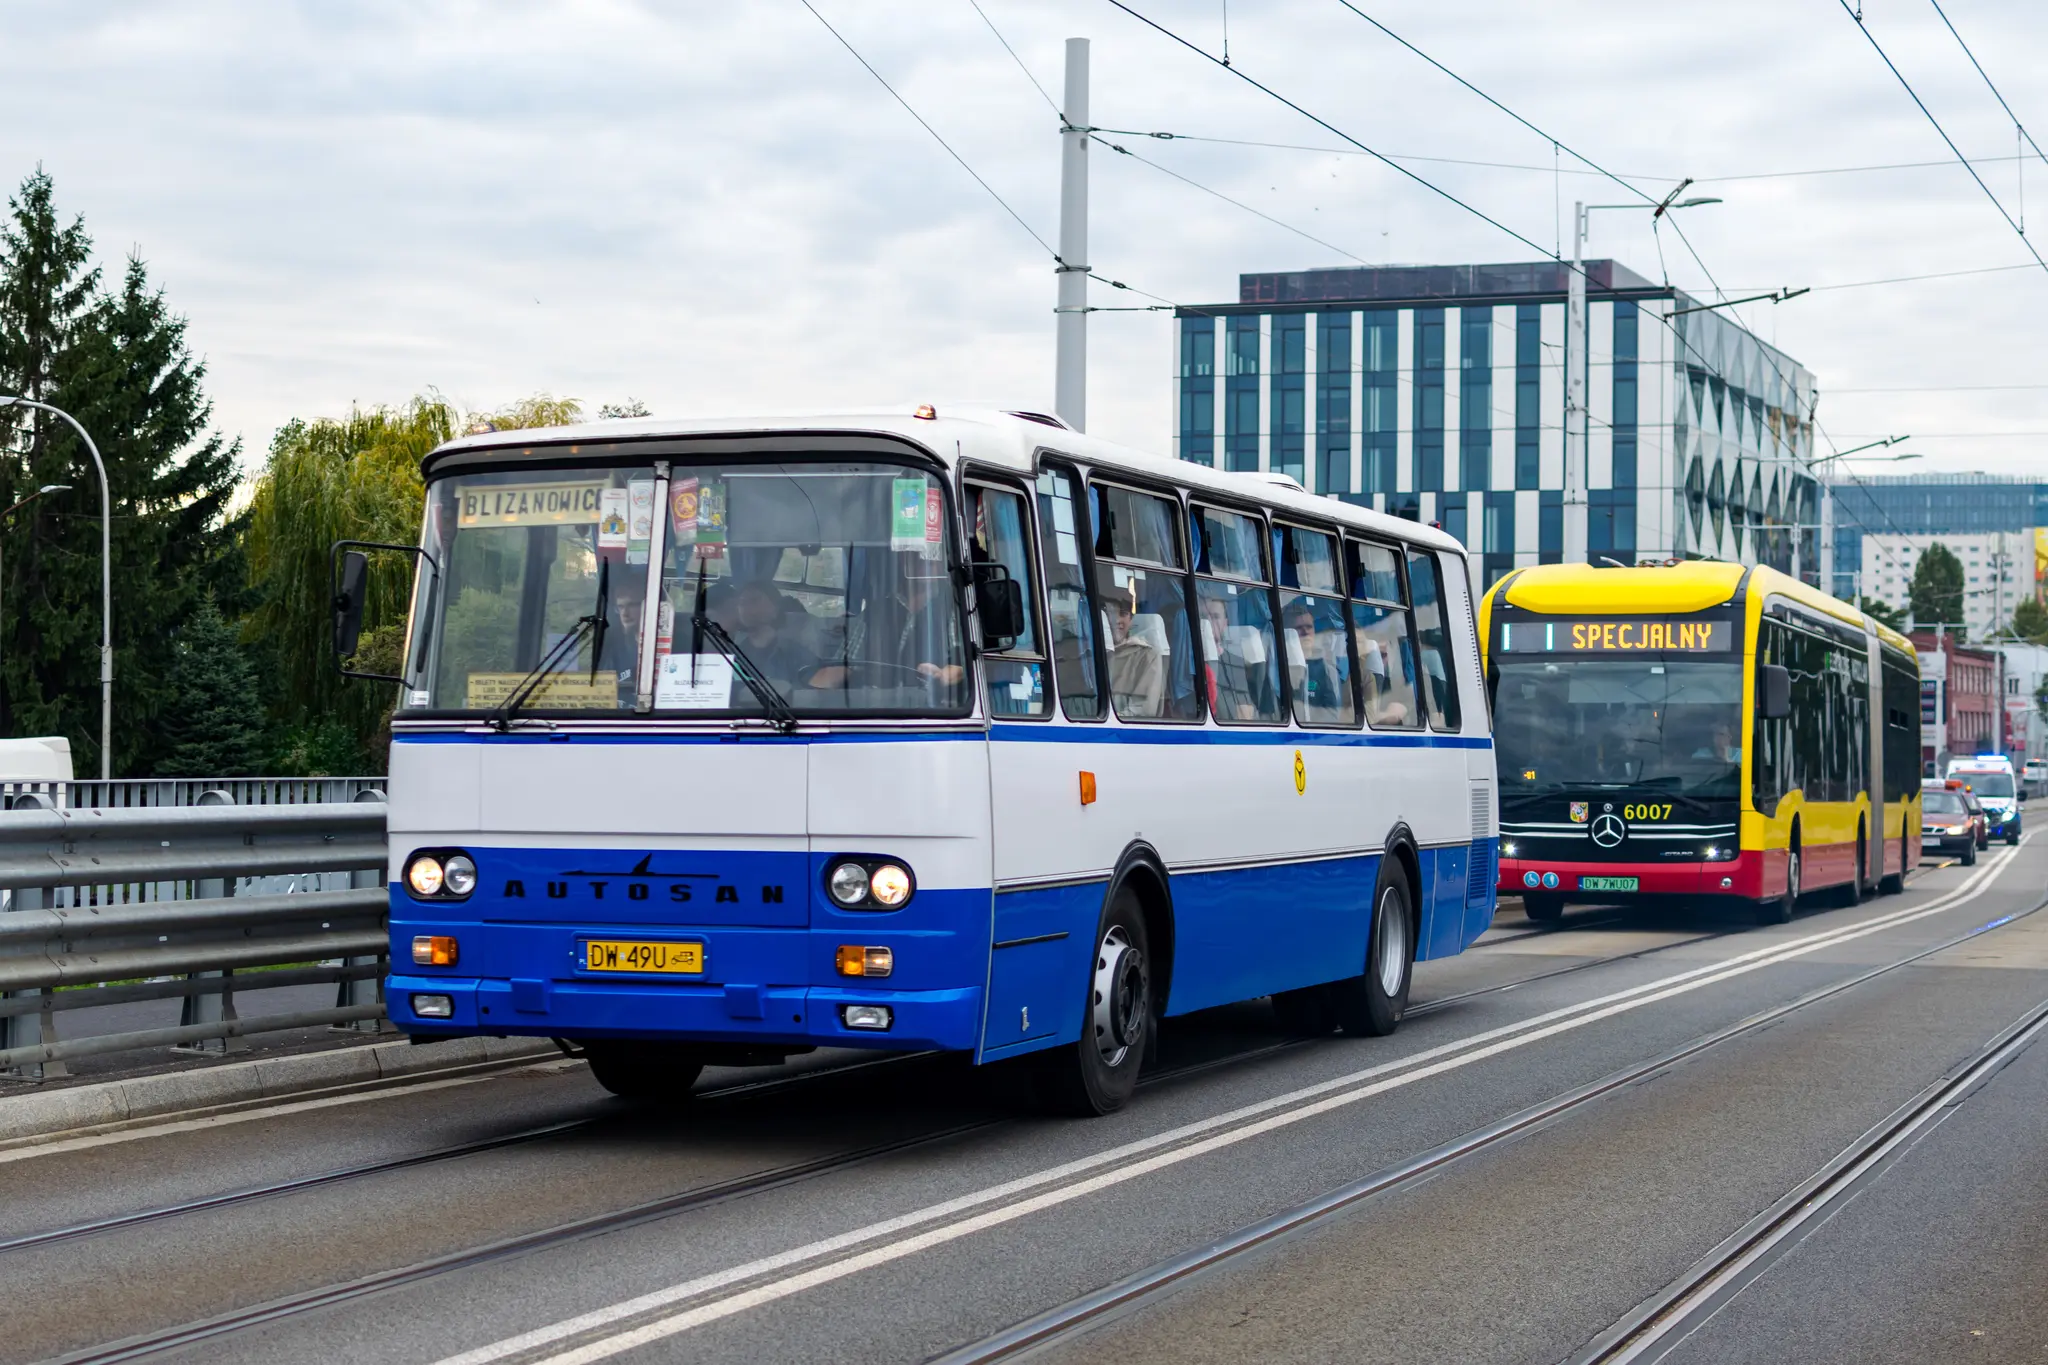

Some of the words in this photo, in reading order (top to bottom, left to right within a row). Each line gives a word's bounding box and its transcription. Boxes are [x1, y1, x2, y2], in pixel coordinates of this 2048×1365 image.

[1572, 623, 1712, 650] SPECJALNY
[1623, 803, 1673, 821] 6007
[503, 879, 785, 904] AUTOSAN
[1585, 878, 1599, 890] DW
[1602, 878, 1636, 890] 7WU07
[591, 944, 619, 968] DW
[626, 945, 666, 969] 49U
